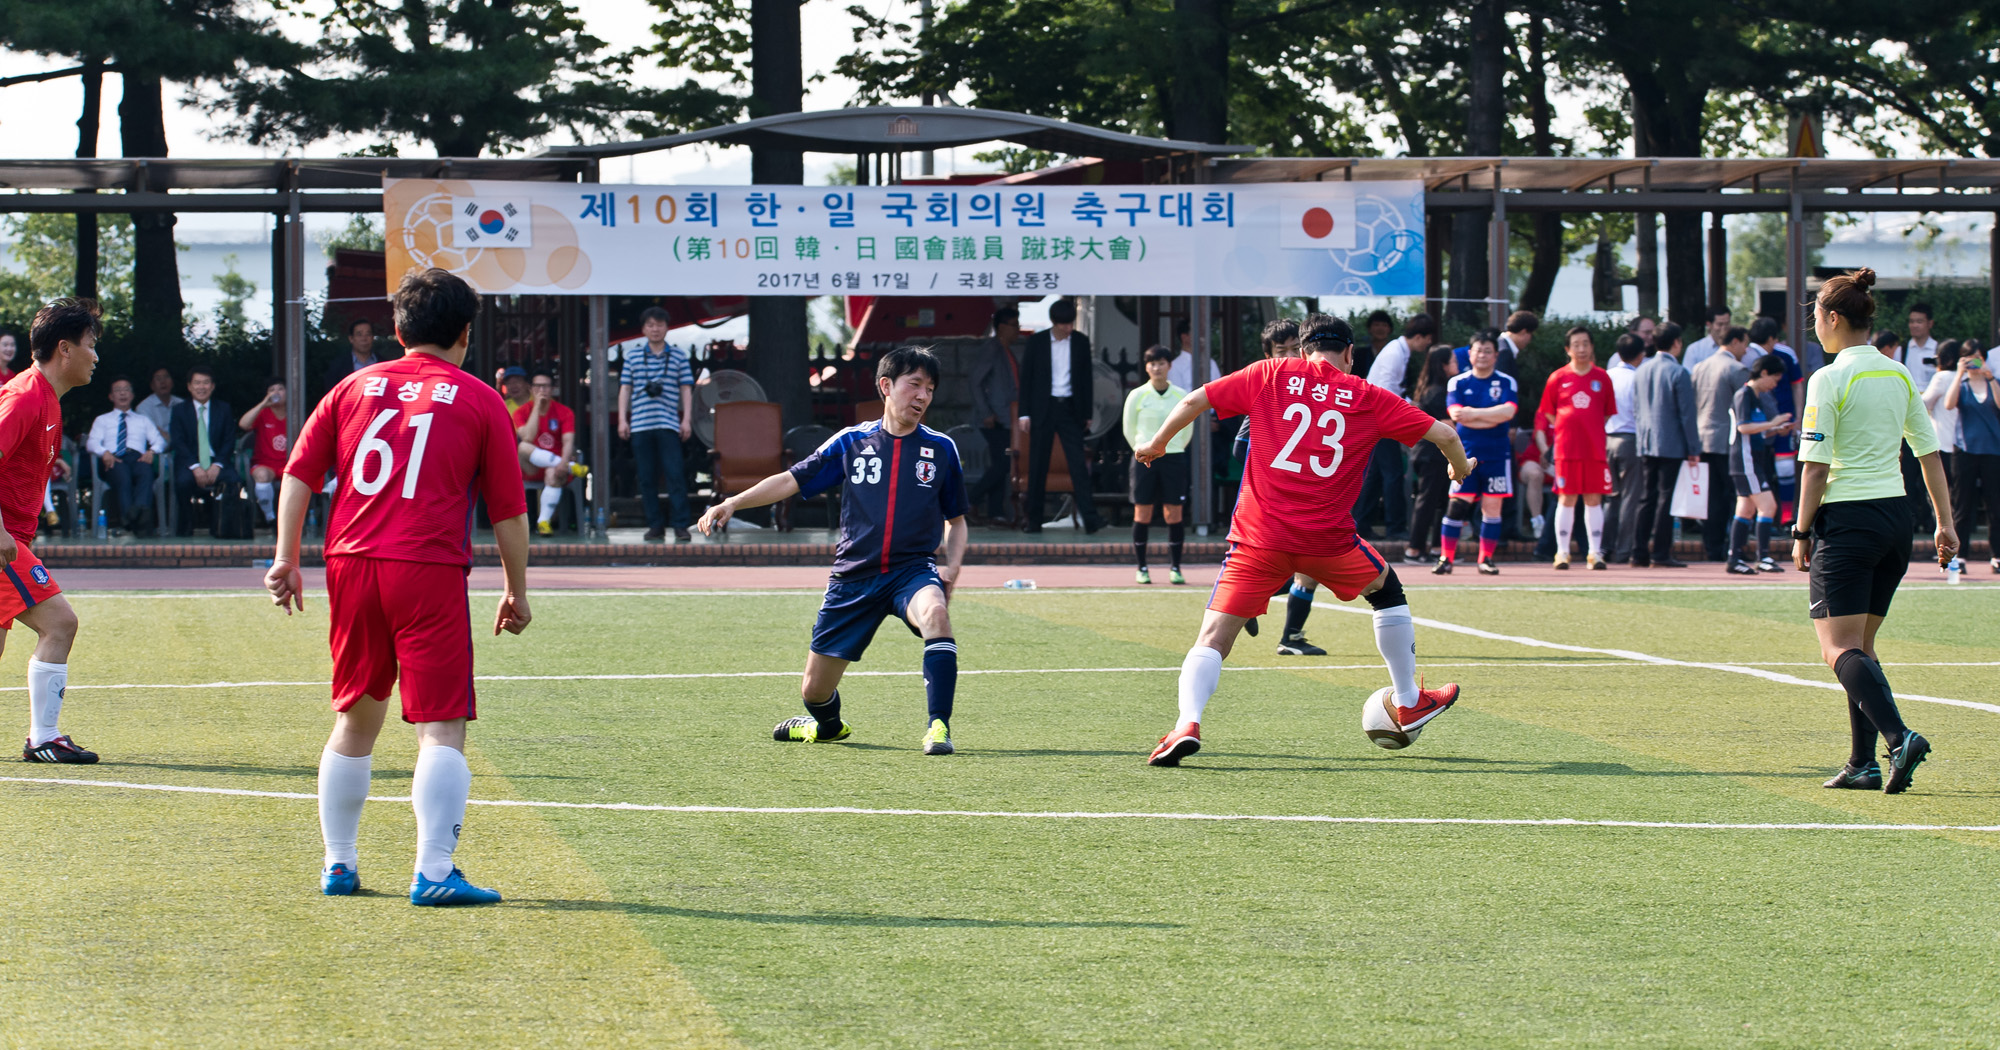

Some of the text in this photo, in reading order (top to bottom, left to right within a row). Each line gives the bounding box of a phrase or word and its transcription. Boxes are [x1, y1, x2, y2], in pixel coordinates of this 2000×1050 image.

[580, 192, 718, 227] 제10회
[881, 192, 1046, 227] 국회의원
[1071, 192, 1234, 228] 축구대회
[895, 235, 1004, 261] 國會議員
[758, 272, 820, 289] 2017년
[831, 272, 860, 289] 6월
[872, 272, 909, 290] 17일
[958, 272, 994, 290] 국회
[1005, 272, 1060, 290] 운동장
[363, 376, 459, 405] 김성원
[1286, 376, 1353, 408] 위성곤
[352, 408, 434, 499] 61
[1269, 402, 1346, 478] 23
[850, 456, 882, 485] 33
